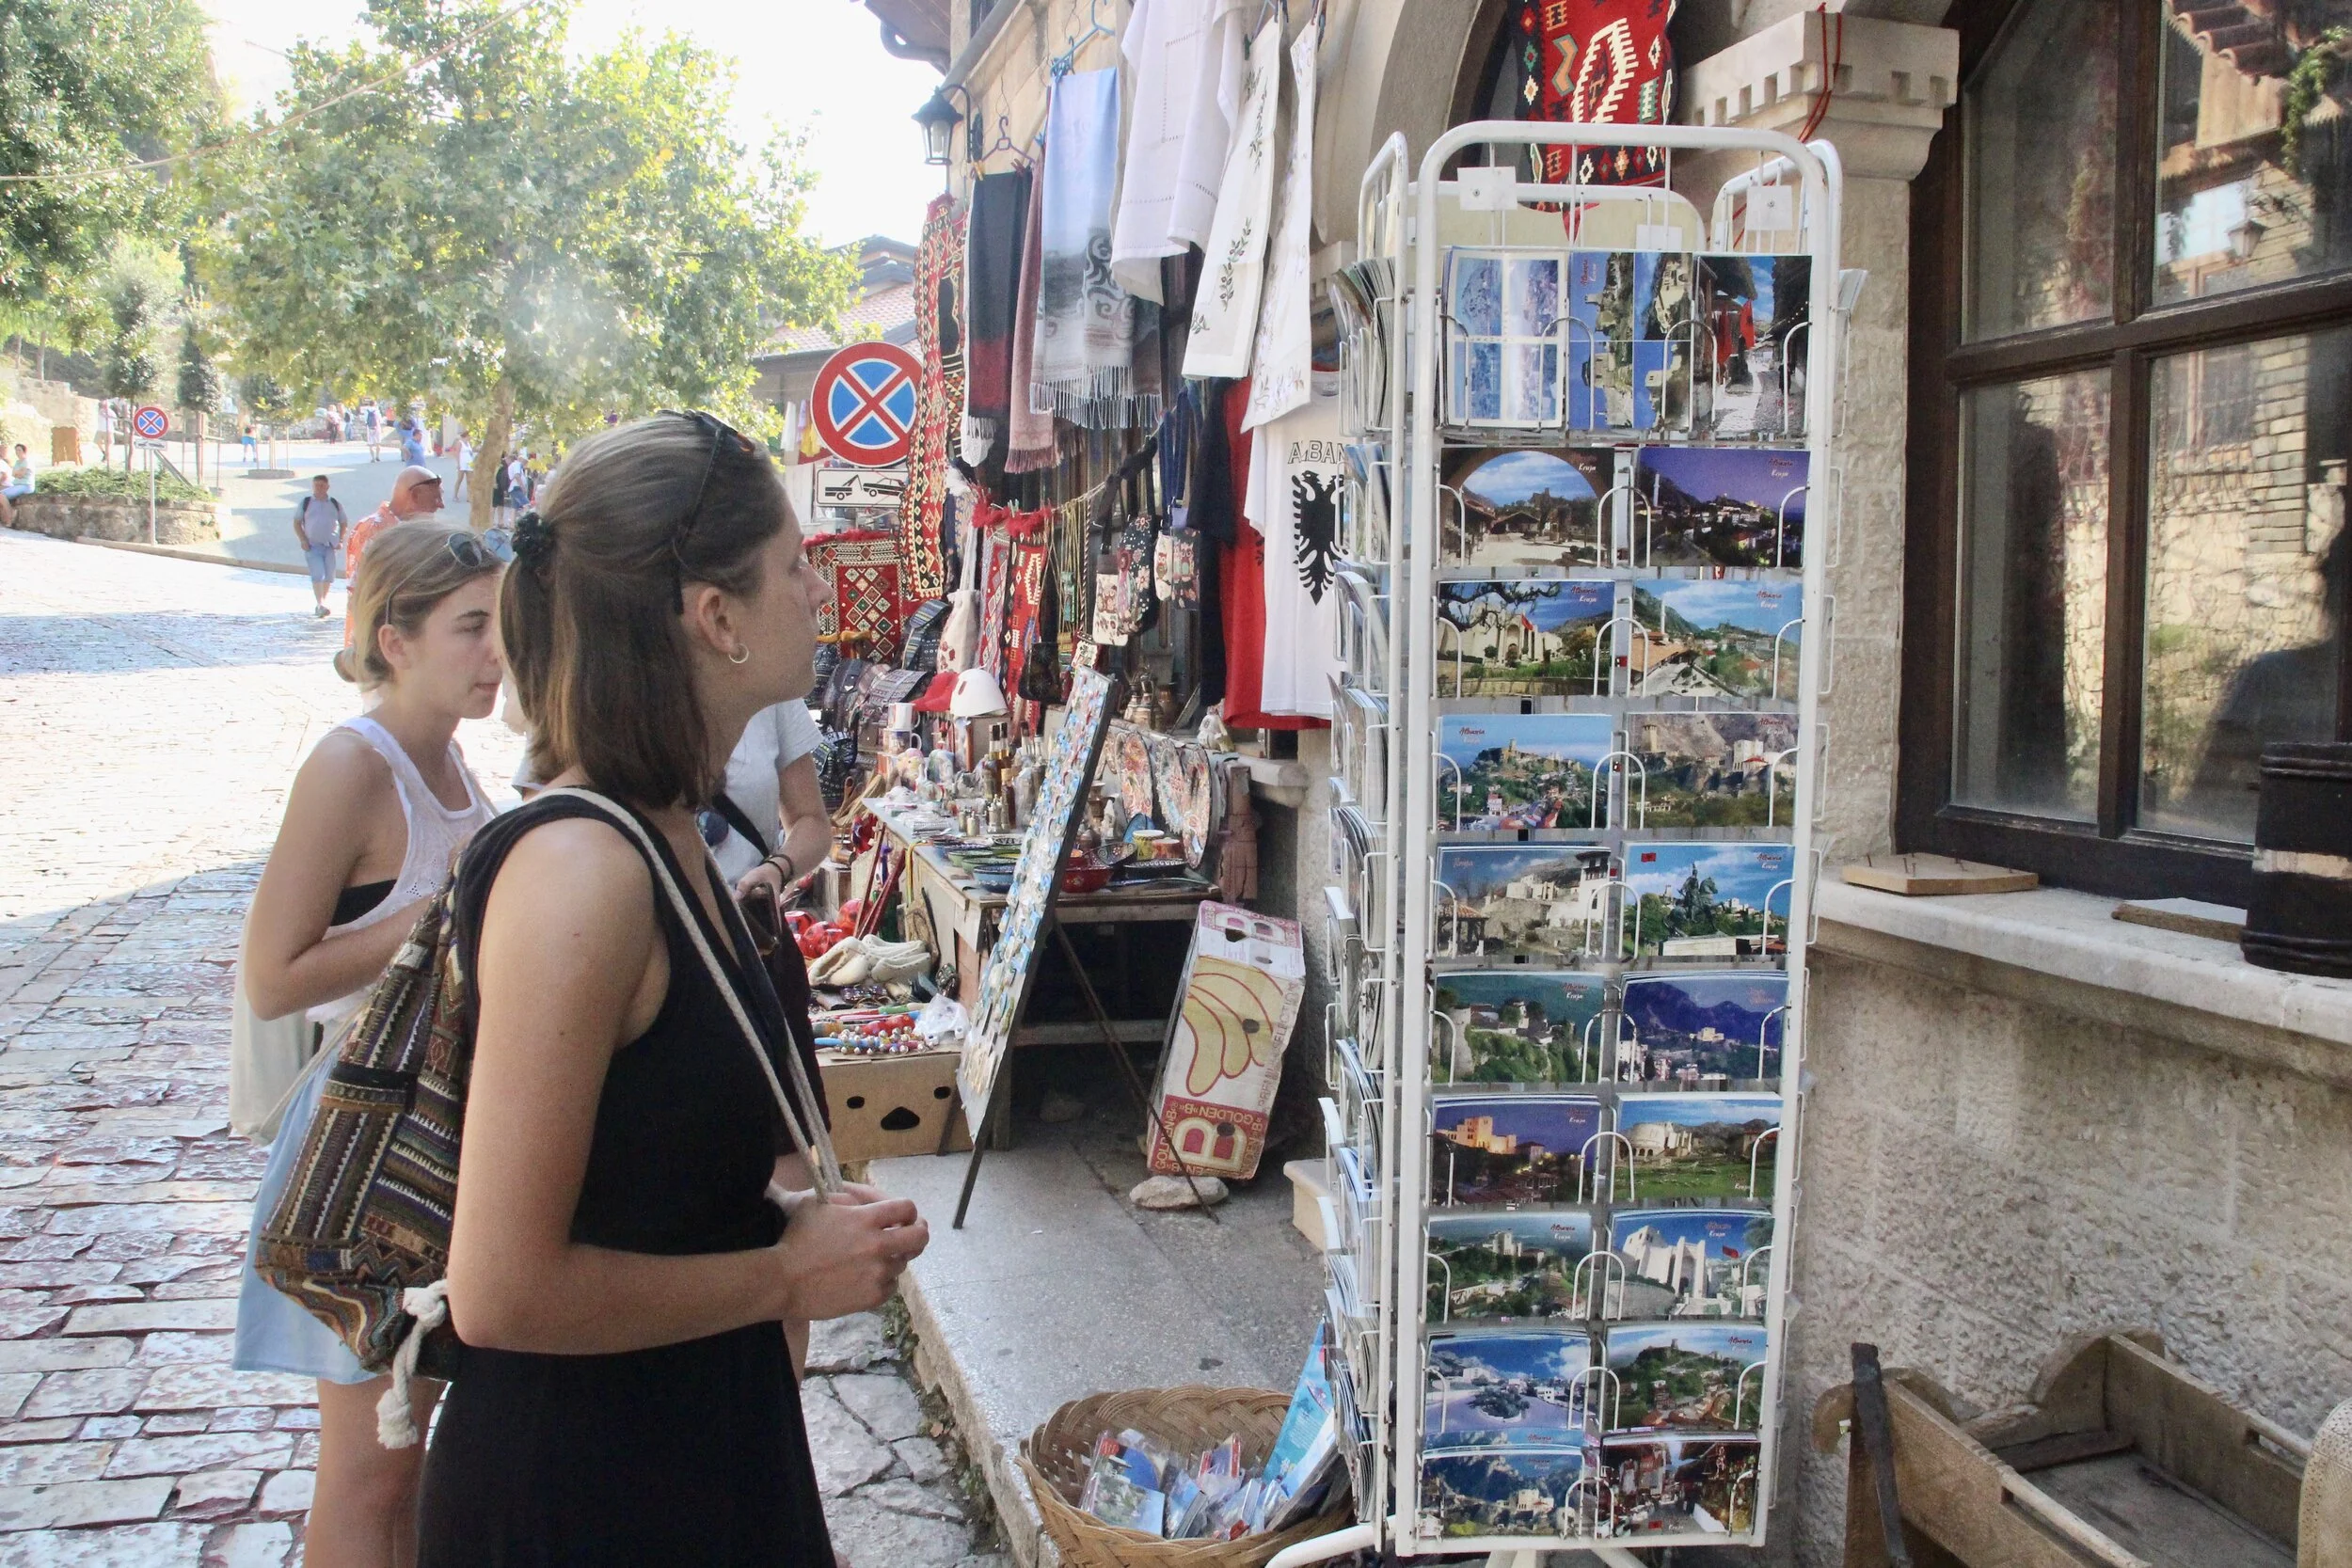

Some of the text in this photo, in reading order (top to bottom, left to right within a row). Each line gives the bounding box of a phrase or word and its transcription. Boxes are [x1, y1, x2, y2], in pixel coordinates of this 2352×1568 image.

[1579, 463, 1597, 473] Kruja
[1571, 586, 1597, 594] Albania
[1756, 591, 1782, 599] Albania
[1580, 595, 1597, 605] Kruja
[1759, 718, 1784, 726] Albania
[1459, 726, 1485, 736] Albania
[1756, 853, 1782, 862] Albania
[1199, 1104, 1254, 1126] GOLDEN
[1172, 1117, 1248, 1173] B
[1727, 1336, 1753, 1344] Albania
